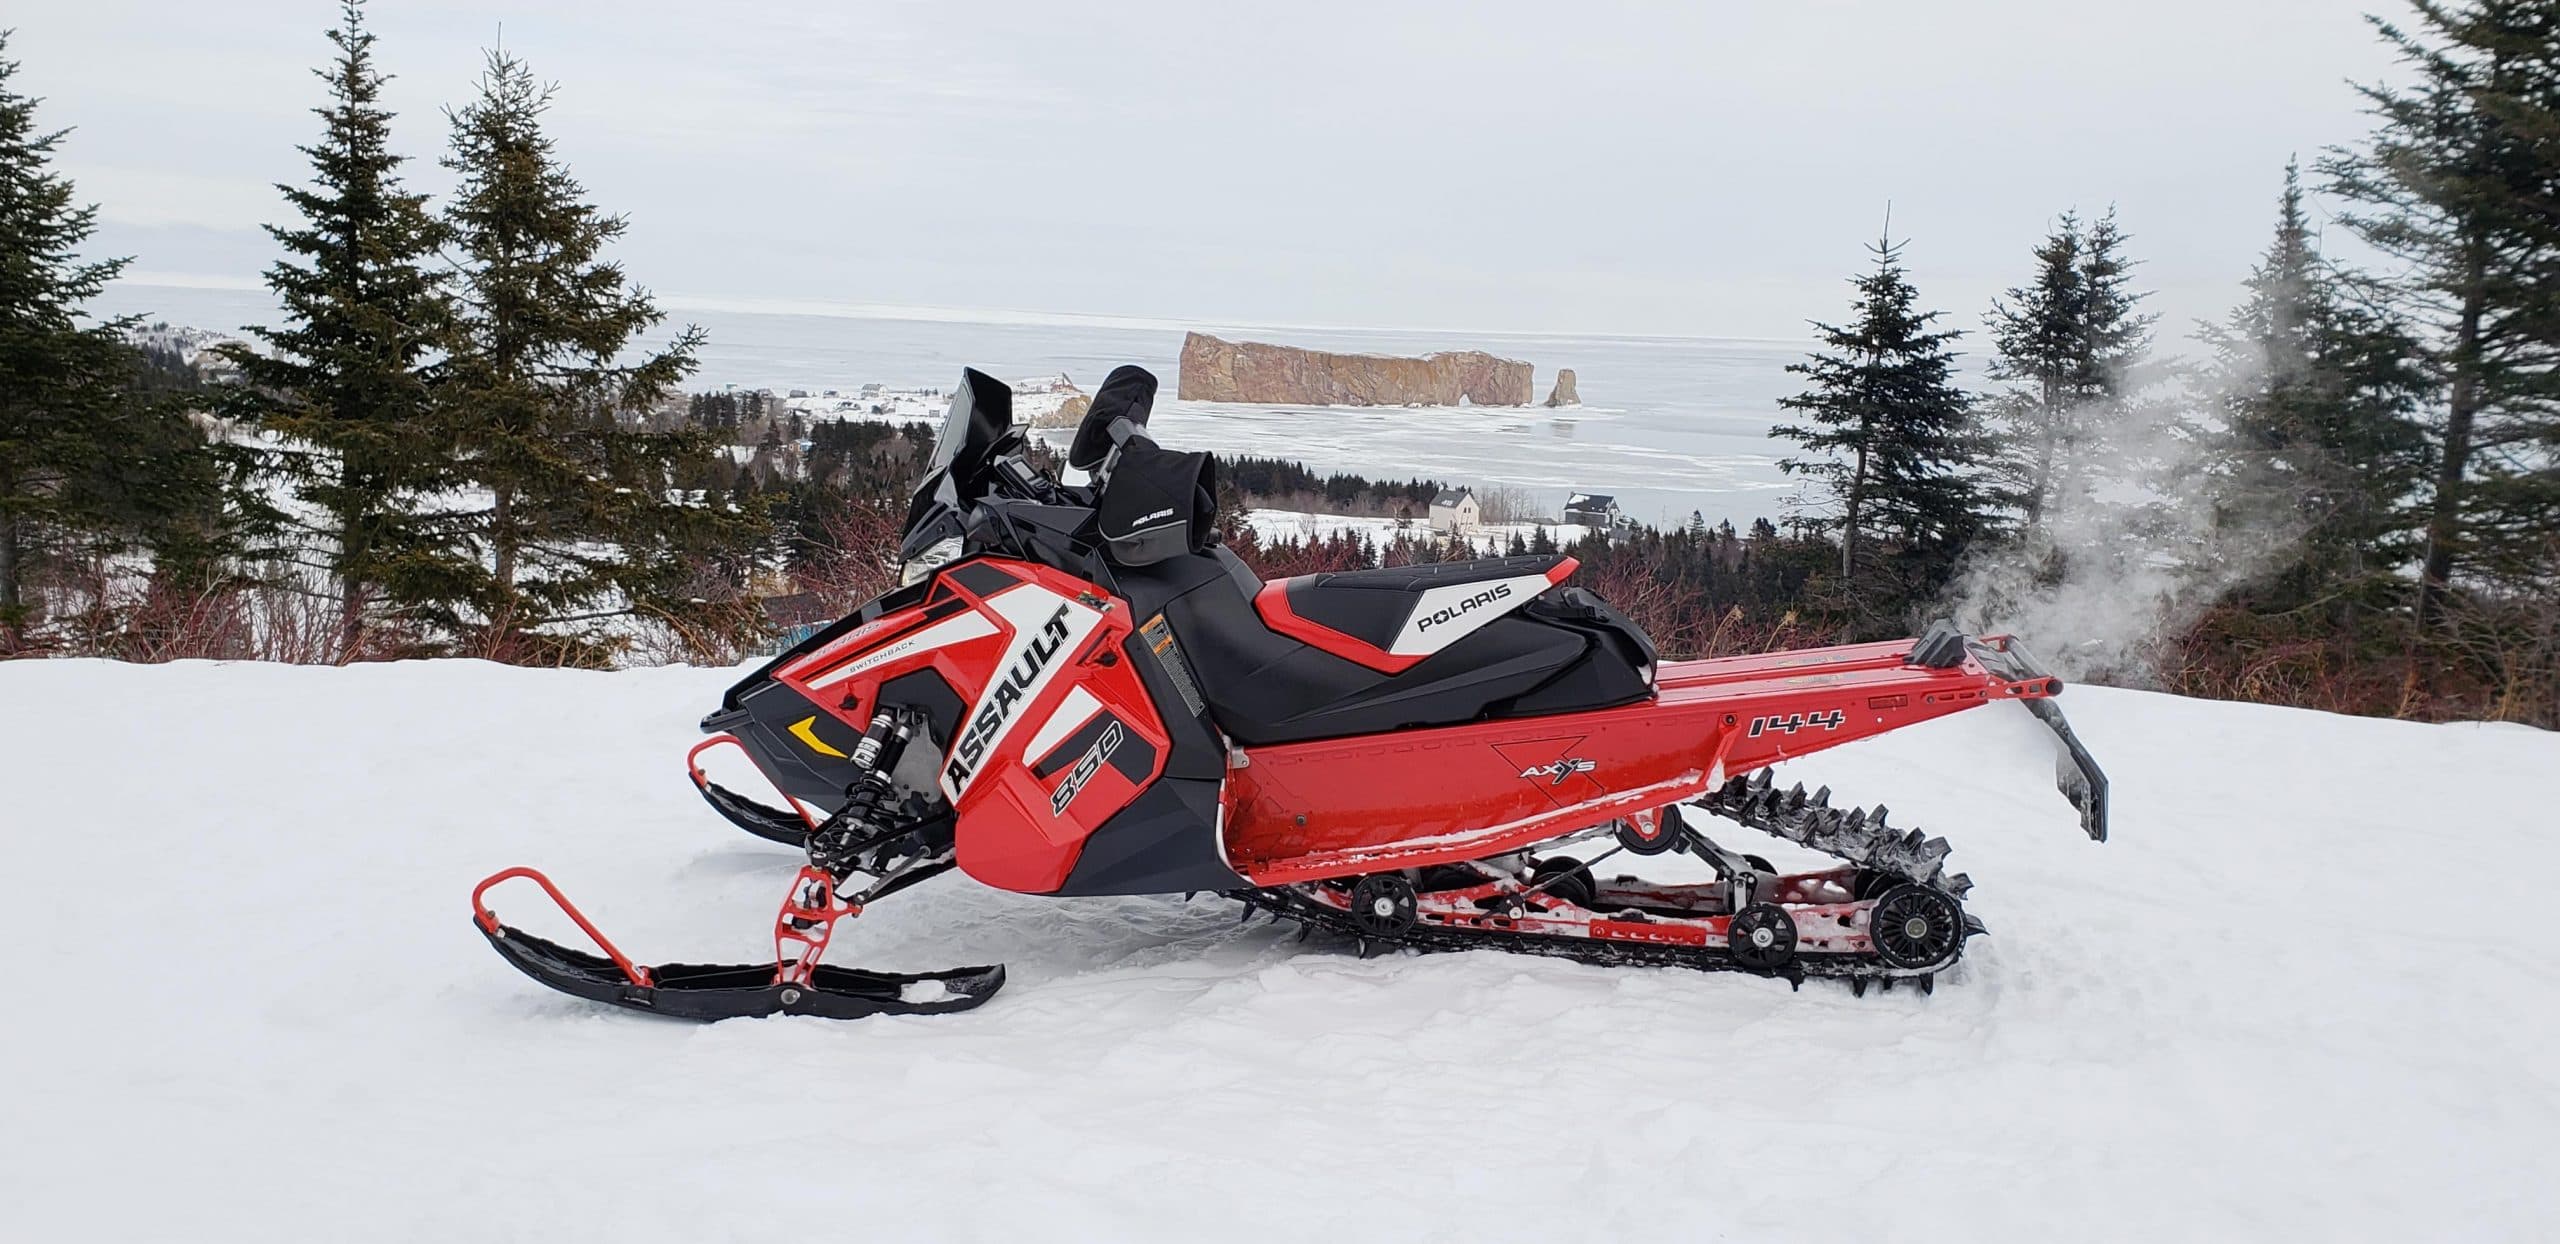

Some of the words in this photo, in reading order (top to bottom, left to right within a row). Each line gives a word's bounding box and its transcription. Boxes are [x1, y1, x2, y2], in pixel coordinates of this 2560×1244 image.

[1131, 507, 1175, 528] POLARIS
[1416, 583, 1512, 633] POLARIS
[849, 639, 916, 673] SWITCHBACK
[946, 600, 1072, 796] ASSAULT
[1748, 709, 1846, 738] 144
[1051, 720, 1124, 817] 850
